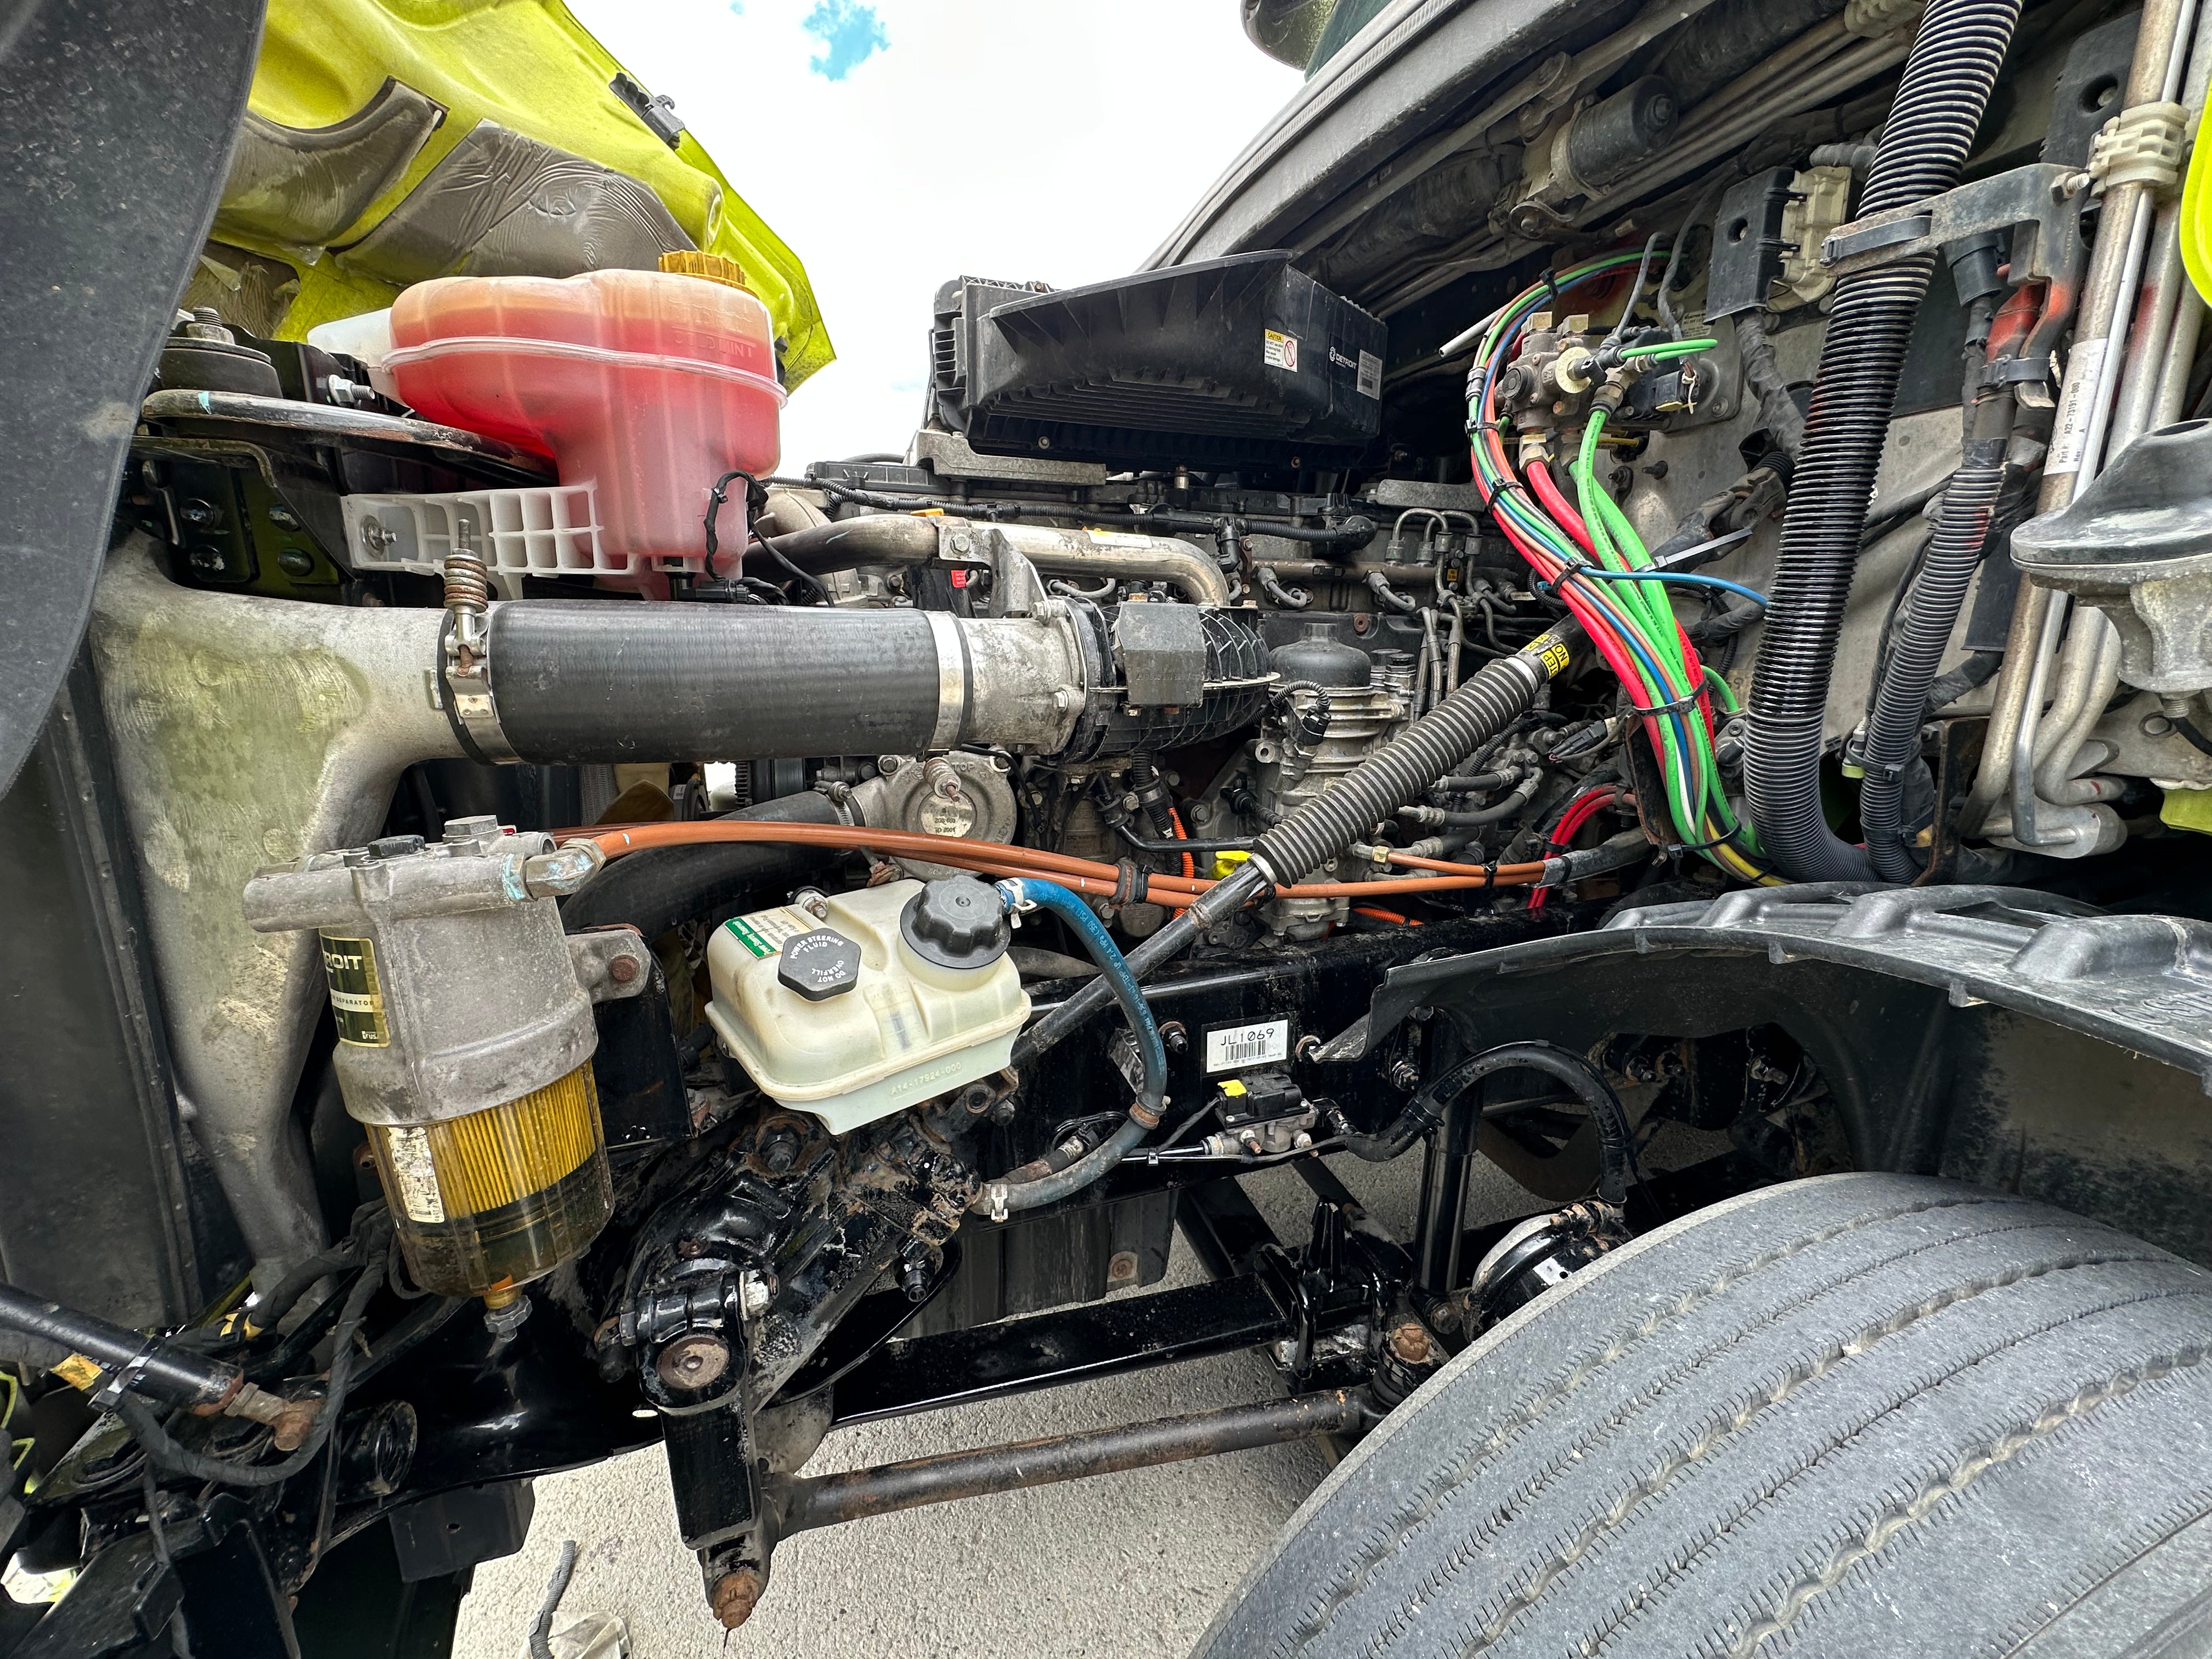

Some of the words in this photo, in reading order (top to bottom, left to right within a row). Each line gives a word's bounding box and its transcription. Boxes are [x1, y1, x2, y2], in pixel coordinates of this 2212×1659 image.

[1336, 353, 1357, 369] DETROIT
[951, 762, 975, 771] TOP
[789, 940, 808, 960] POWER
[807, 935, 844, 947] STEERING
[803, 941, 828, 953] FLUID
[323, 951, 362, 970] ROIT
[811, 960, 845, 976] OVERFILL
[834, 970, 847, 979] DO
[336, 996, 375, 1006] SEPARATOR
[1220, 1028, 1274, 1046] JL1069
[890, 1062, 963, 1096] A14-17924-000
